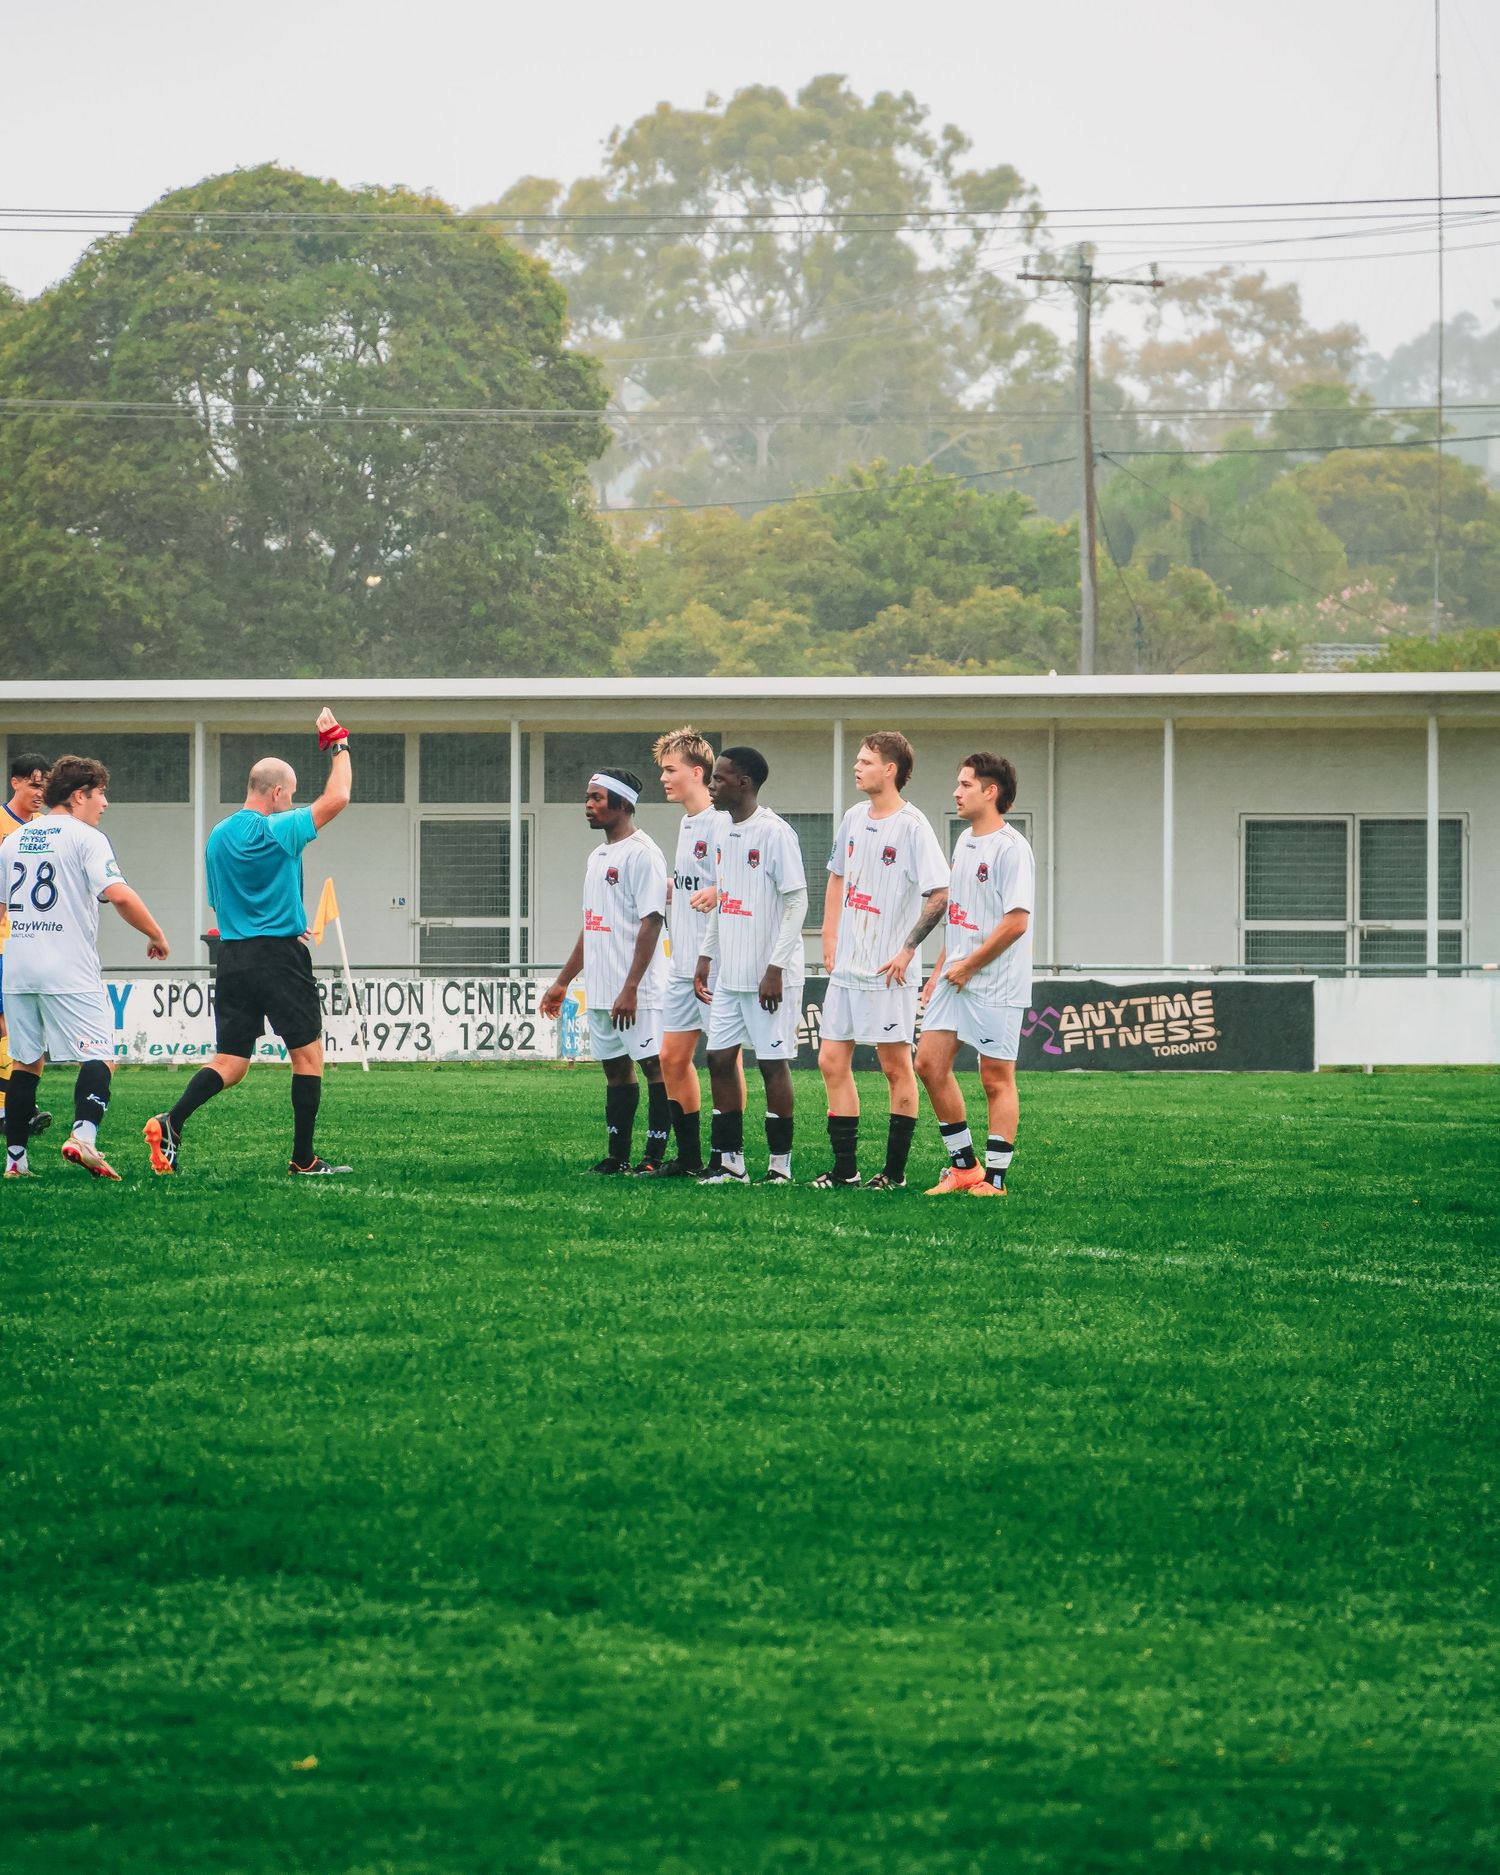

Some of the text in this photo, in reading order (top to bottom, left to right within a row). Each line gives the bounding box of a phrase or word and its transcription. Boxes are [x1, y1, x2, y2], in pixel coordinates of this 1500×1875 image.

[19, 843, 50, 851] THERAPY
[23, 827, 61, 836] THORNTON
[8, 860, 59, 912] 28
[152, 983, 216, 1018] SPOR
[317, 982, 424, 1016] REATION
[442, 982, 536, 1016] CENTRE
[1059, 990, 1214, 1031] ANYTIME
[149, 1042, 216, 1056] ever
[253, 1043, 287, 1061] ay
[325, 1031, 344, 1052] h.
[351, 1022, 432, 1051] 4973
[459, 1022, 536, 1051] 1262
[1063, 1017, 1217, 1053] FITNESS
[1152, 1040, 1217, 1057] TORONTO
